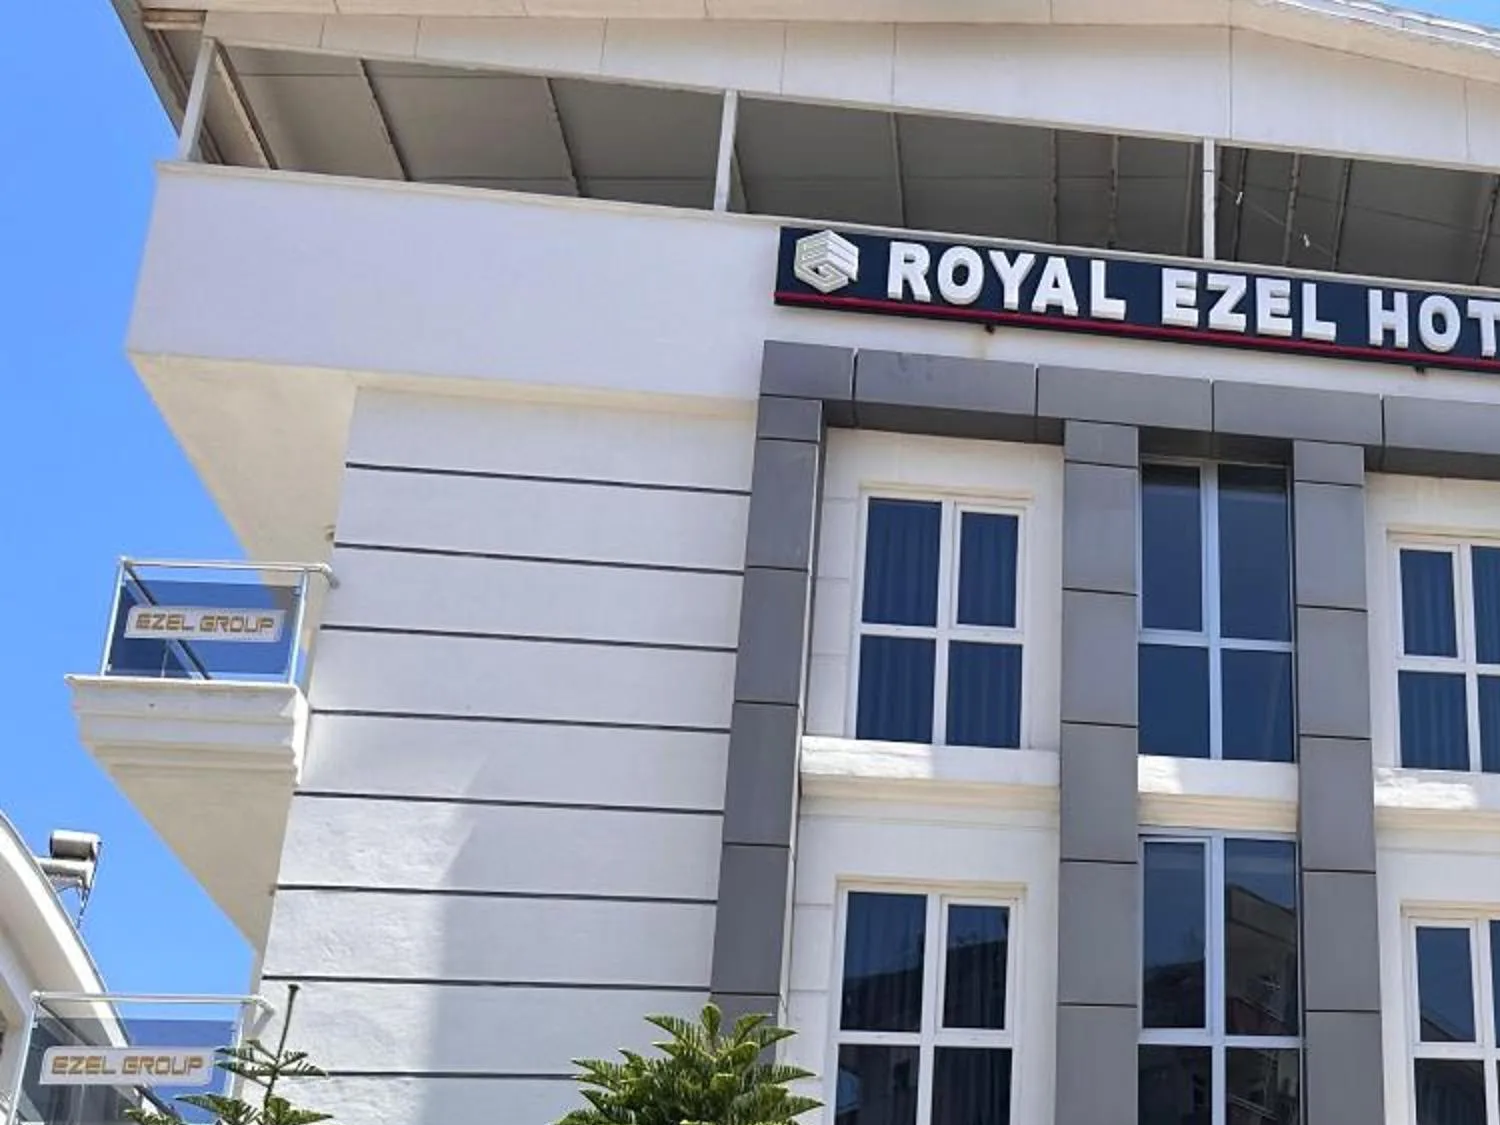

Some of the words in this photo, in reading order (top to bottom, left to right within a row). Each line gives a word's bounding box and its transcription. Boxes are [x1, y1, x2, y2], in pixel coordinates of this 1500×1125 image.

[887, 240, 1126, 321] ROYAL
[1161, 267, 1337, 342] EZEL
[135, 613, 194, 631] EZEL
[199, 614, 274, 633] GROUP
[51, 1055, 116, 1075] EZEL
[121, 1055, 204, 1076] GROUP
